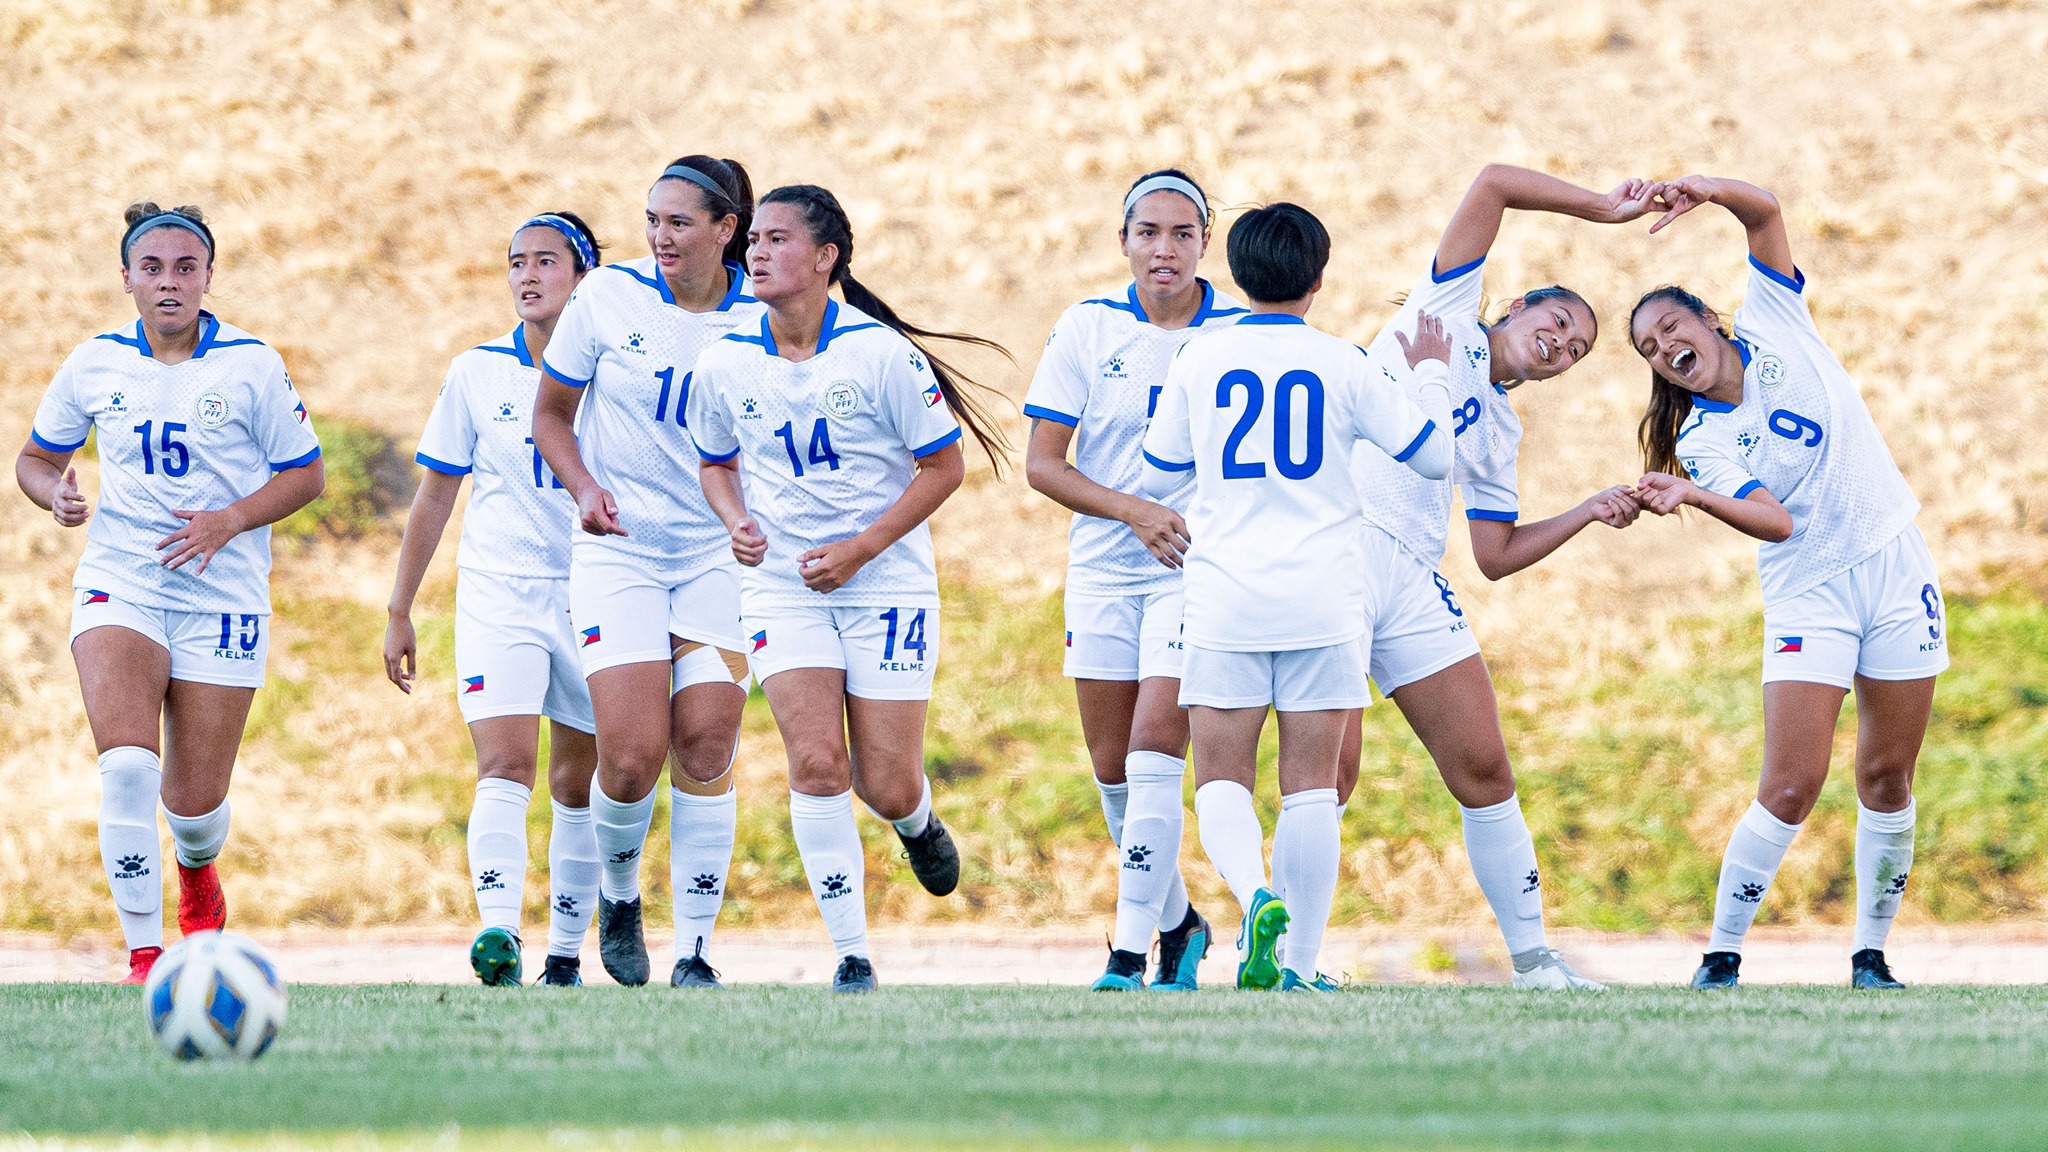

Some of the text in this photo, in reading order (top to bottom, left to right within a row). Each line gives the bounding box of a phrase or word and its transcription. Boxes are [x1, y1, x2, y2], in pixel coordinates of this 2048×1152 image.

[621, 345, 648, 356] KELME
[1215, 368, 1325, 480] 20
[1452, 396, 1481, 438] 8
[1768, 408, 1823, 448] 9
[133, 419, 190, 478] 15
[774, 417, 840, 478] 14
[524, 437, 566, 489] 1
[1921, 583, 1941, 640] 9
[219, 613, 260, 652] 15
[879, 606, 927, 661] 14
[1449, 621, 1468, 633] KEL
[214, 649, 256, 661] KELME
[879, 662, 924, 672] KELME
[114, 868, 150, 879] KELME
[1123, 862, 1152, 872] KELME
[477, 882, 506, 893] KELME
[686, 888, 720, 896] KELME
[821, 886, 852, 901] KELME
